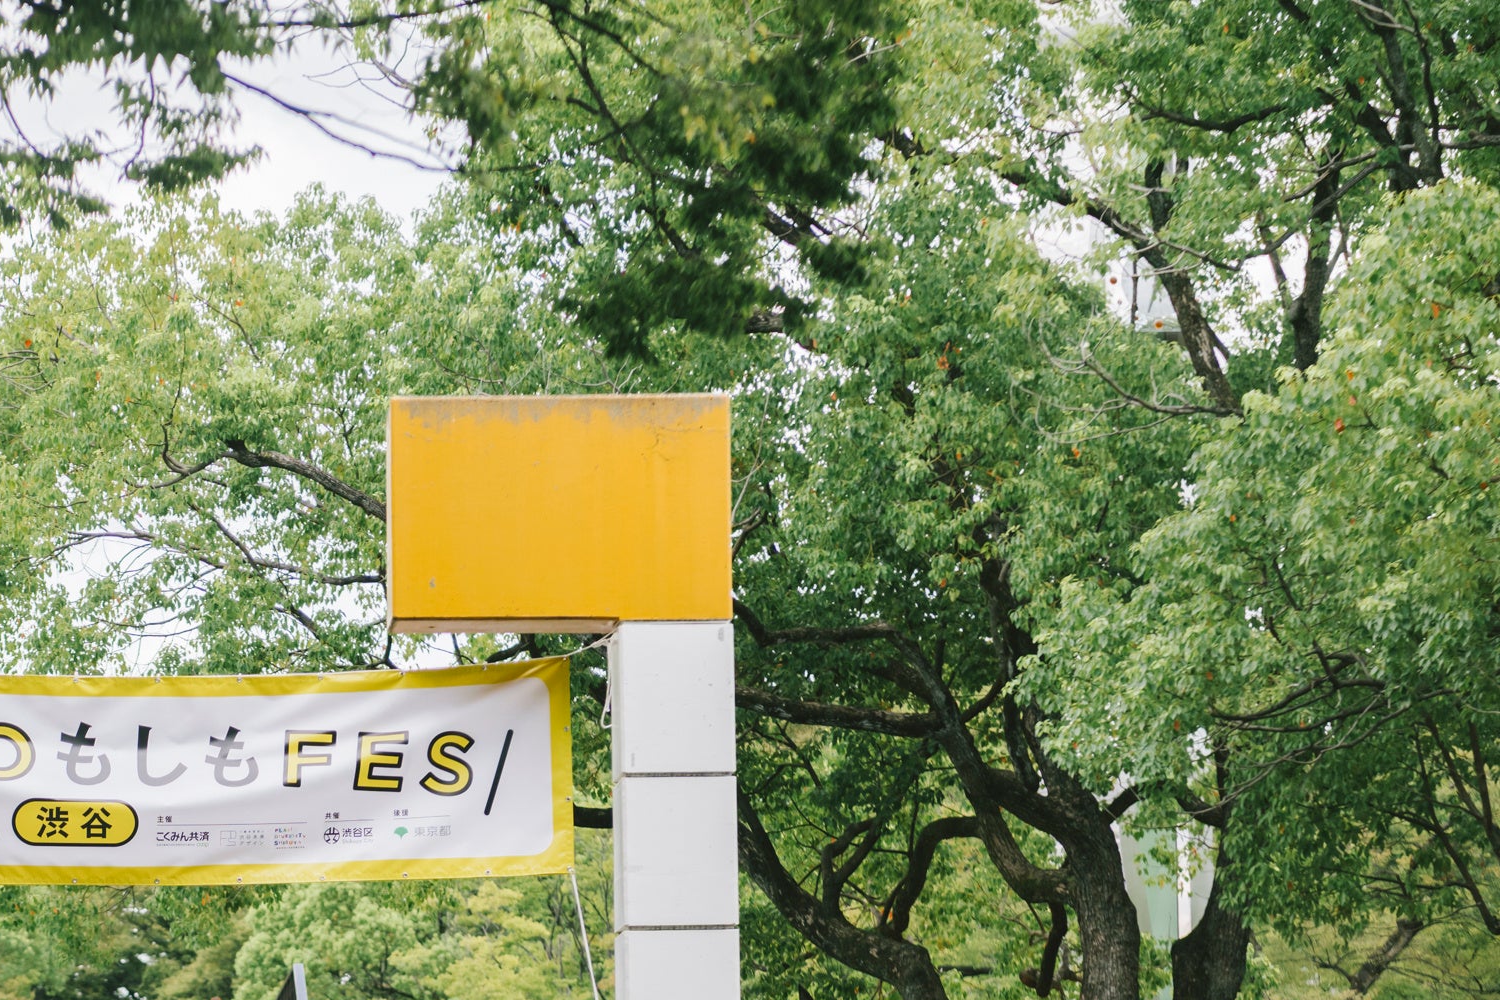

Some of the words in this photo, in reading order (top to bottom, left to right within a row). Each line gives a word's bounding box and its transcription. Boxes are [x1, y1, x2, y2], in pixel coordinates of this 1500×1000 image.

[36, 806, 112, 839] 渋谷
[156, 831, 210, 842] こくみん共済
[342, 827, 373, 838] 渋谷区
[414, 825, 451, 838] 東京都
